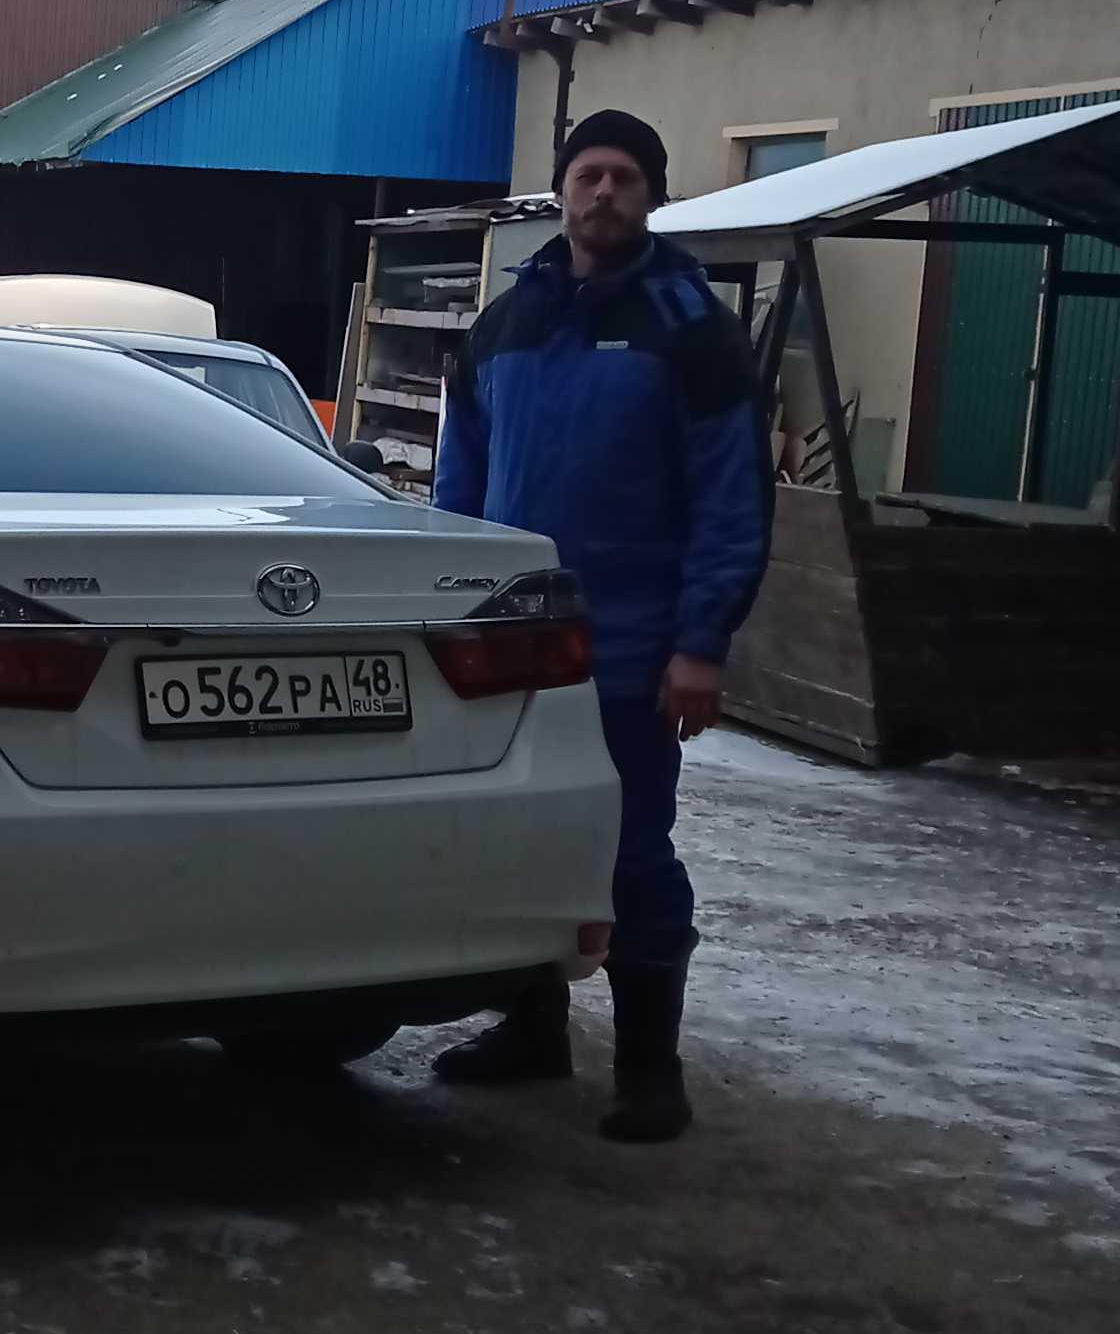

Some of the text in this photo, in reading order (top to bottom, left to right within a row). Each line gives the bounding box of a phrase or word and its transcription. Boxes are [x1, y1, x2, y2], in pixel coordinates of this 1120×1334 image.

[23, 577, 101, 594] TOYOTA
[352, 658, 392, 697] 48
[352, 698, 383, 713] RUS
